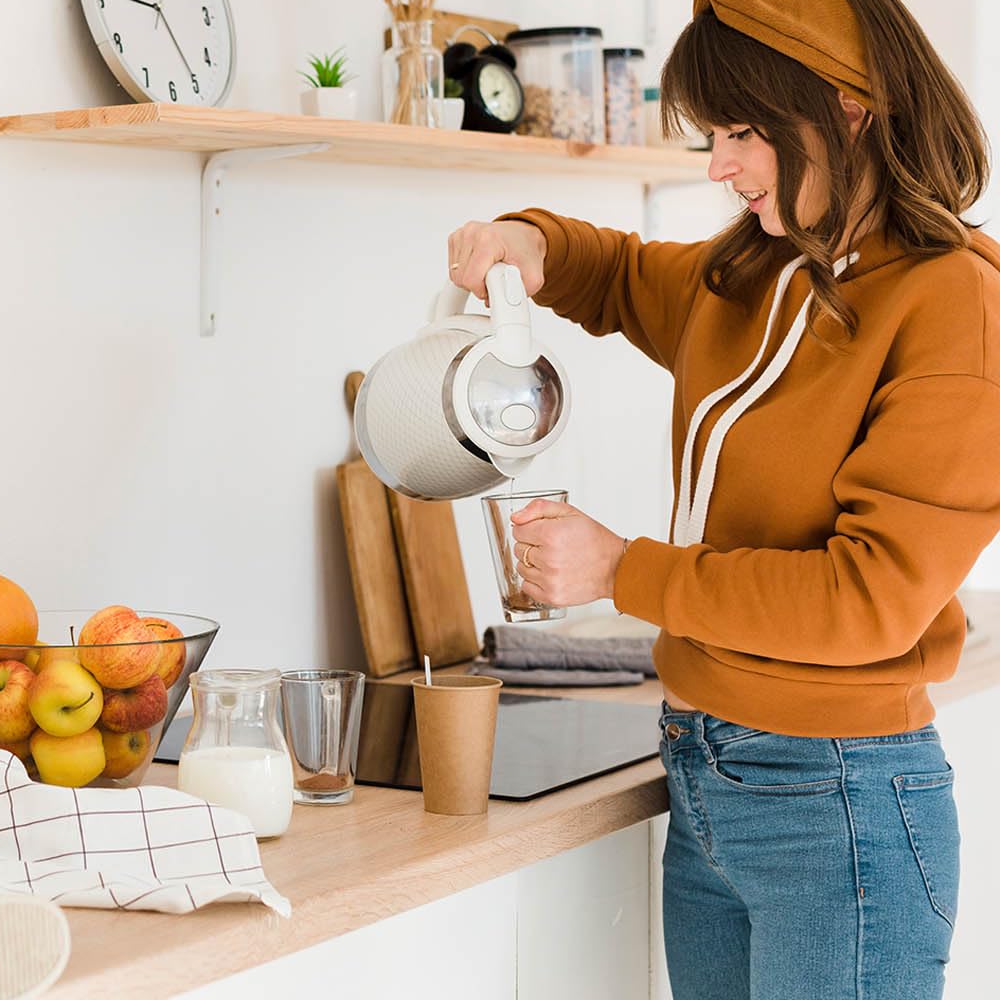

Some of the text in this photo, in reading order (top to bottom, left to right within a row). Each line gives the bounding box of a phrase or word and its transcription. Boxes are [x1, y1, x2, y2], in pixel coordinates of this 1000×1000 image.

[202, 6, 211, 26] 3
[204, 47, 211, 66] 4
[142, 67, 149, 88] 7
[191, 74, 199, 93] 5
[169, 81, 177, 102] 6
